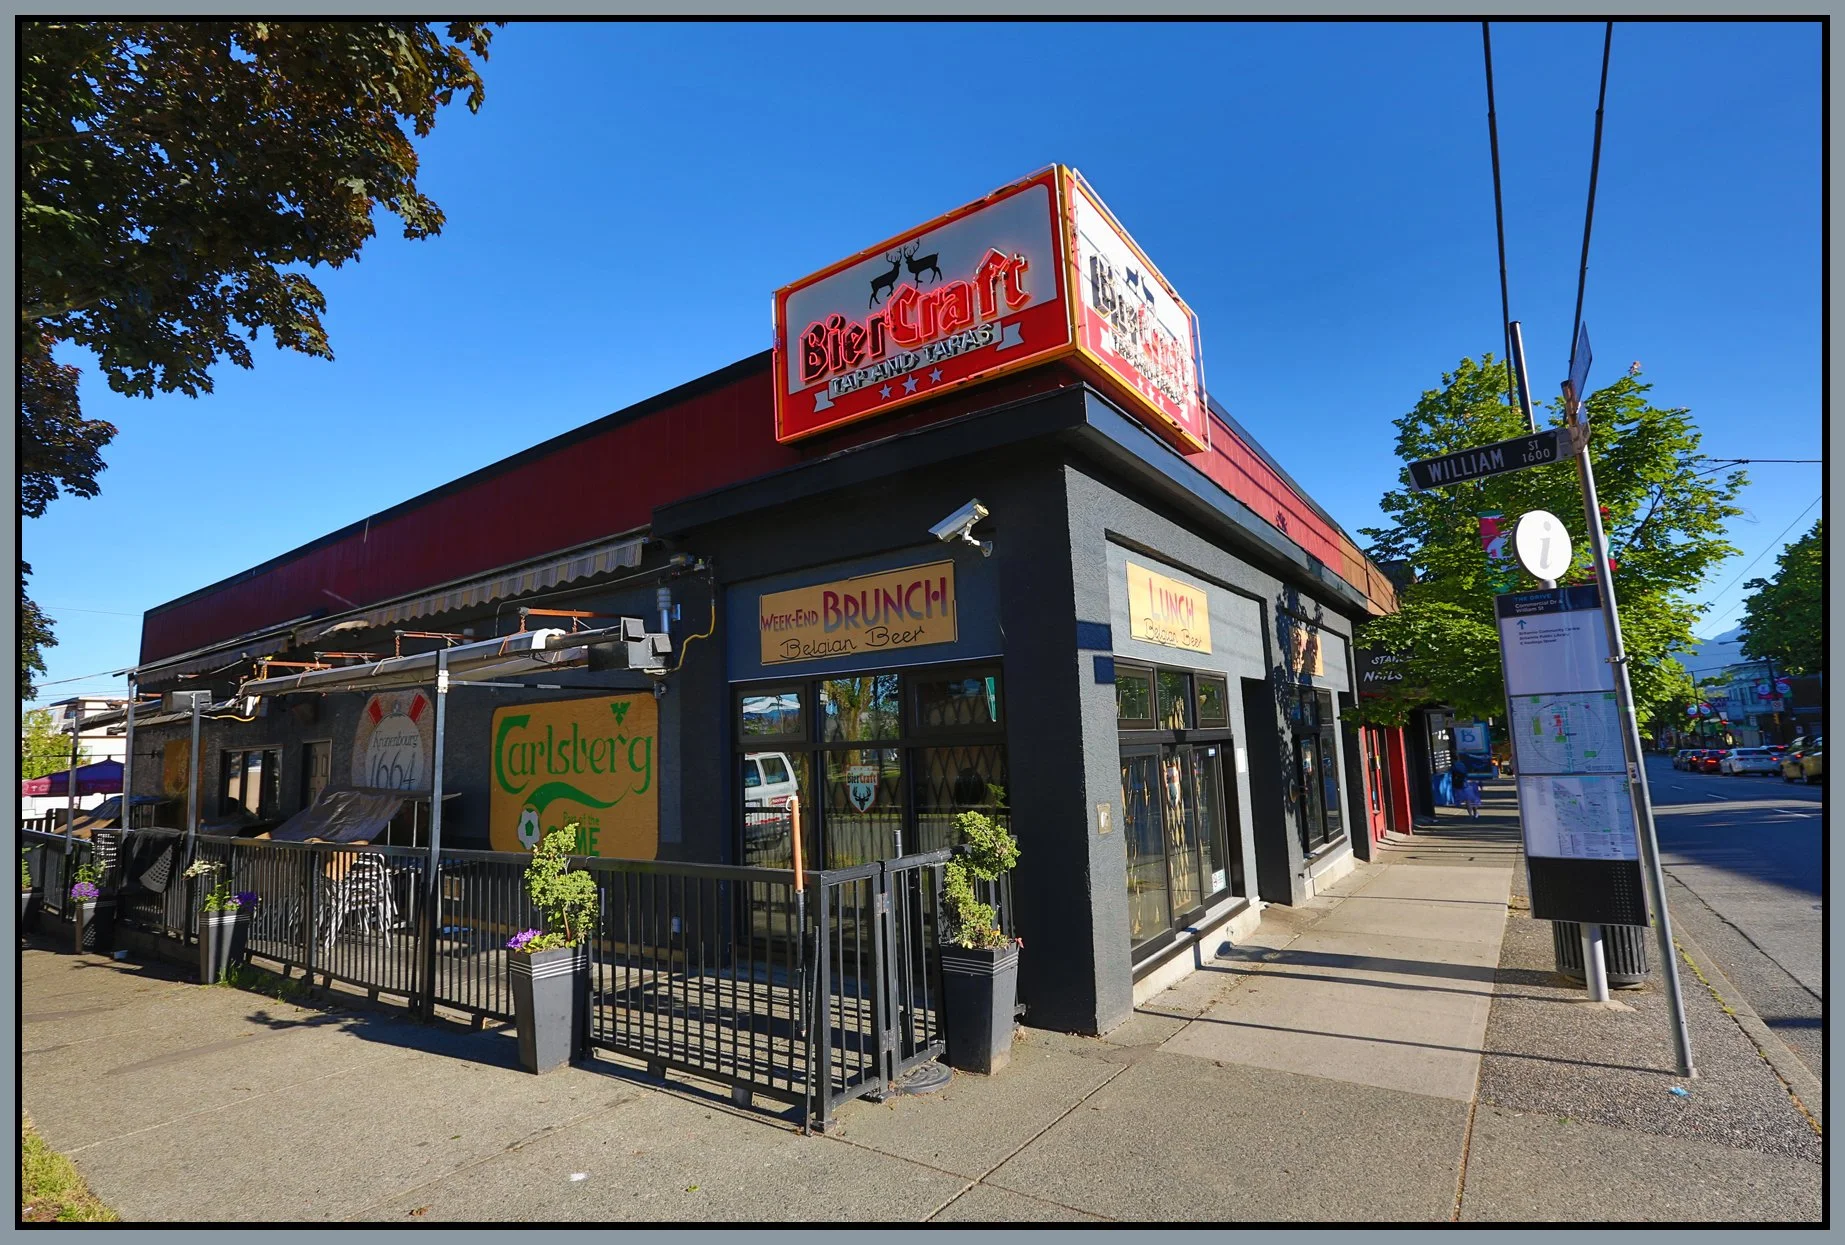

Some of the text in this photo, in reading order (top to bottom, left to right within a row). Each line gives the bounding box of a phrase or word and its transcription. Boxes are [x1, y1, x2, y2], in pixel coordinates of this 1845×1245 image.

[830, 323, 995, 395] TAP AND TAPAS
[1427, 439, 1540, 483] WILLIAM ST
[1521, 448, 1551, 464] 1600
[823, 576, 948, 633] BRUNCH
[1148, 577, 1195, 630] LUNCH
[780, 625, 926, 660] Belgian Beer
[370, 751, 417, 790] 1664
[494, 714, 654, 795] Carlsberg
[847, 771, 878, 784] BierCraft
